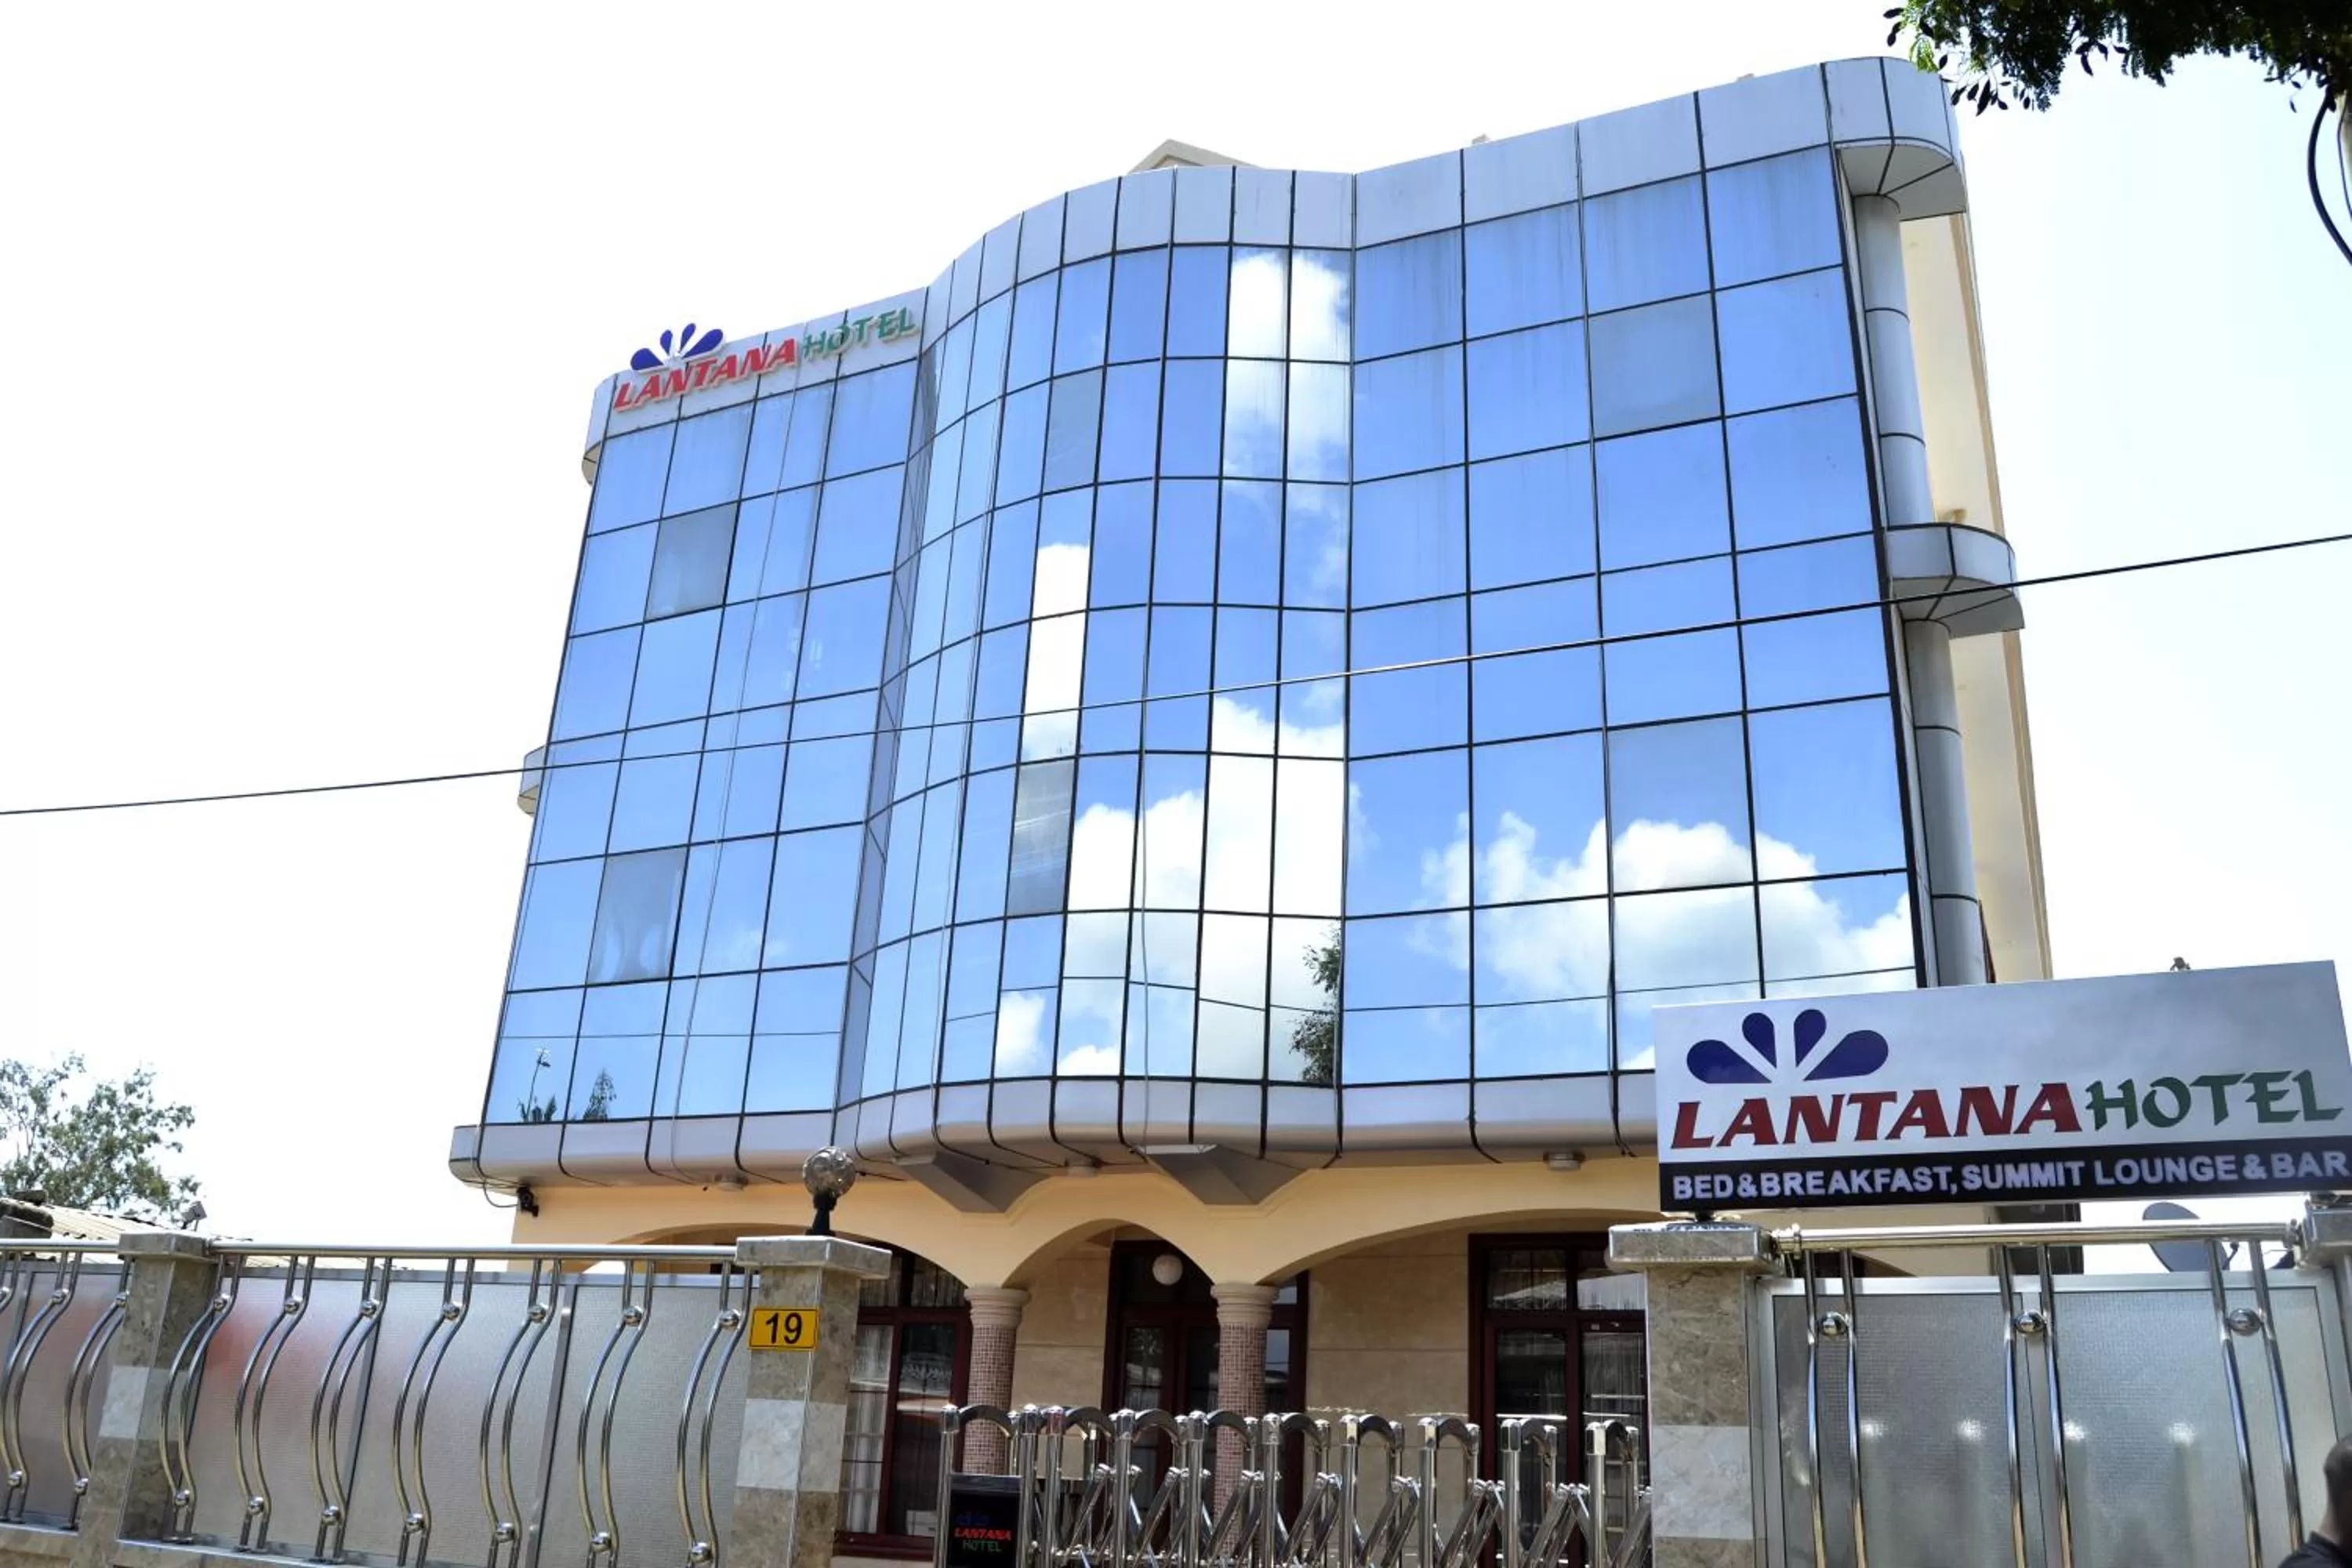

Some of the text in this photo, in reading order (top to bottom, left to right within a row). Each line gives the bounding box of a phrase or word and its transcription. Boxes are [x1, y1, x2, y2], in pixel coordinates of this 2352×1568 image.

[614, 307, 921, 411] LANTANA HOTEL
[1670, 1069, 2345, 1149] LANTANA HOTEL
[1961, 1160, 2085, 1191] SUMMIT
[765, 1312, 803, 1345] 19
[962, 1540, 1002, 1552] HOTEL
